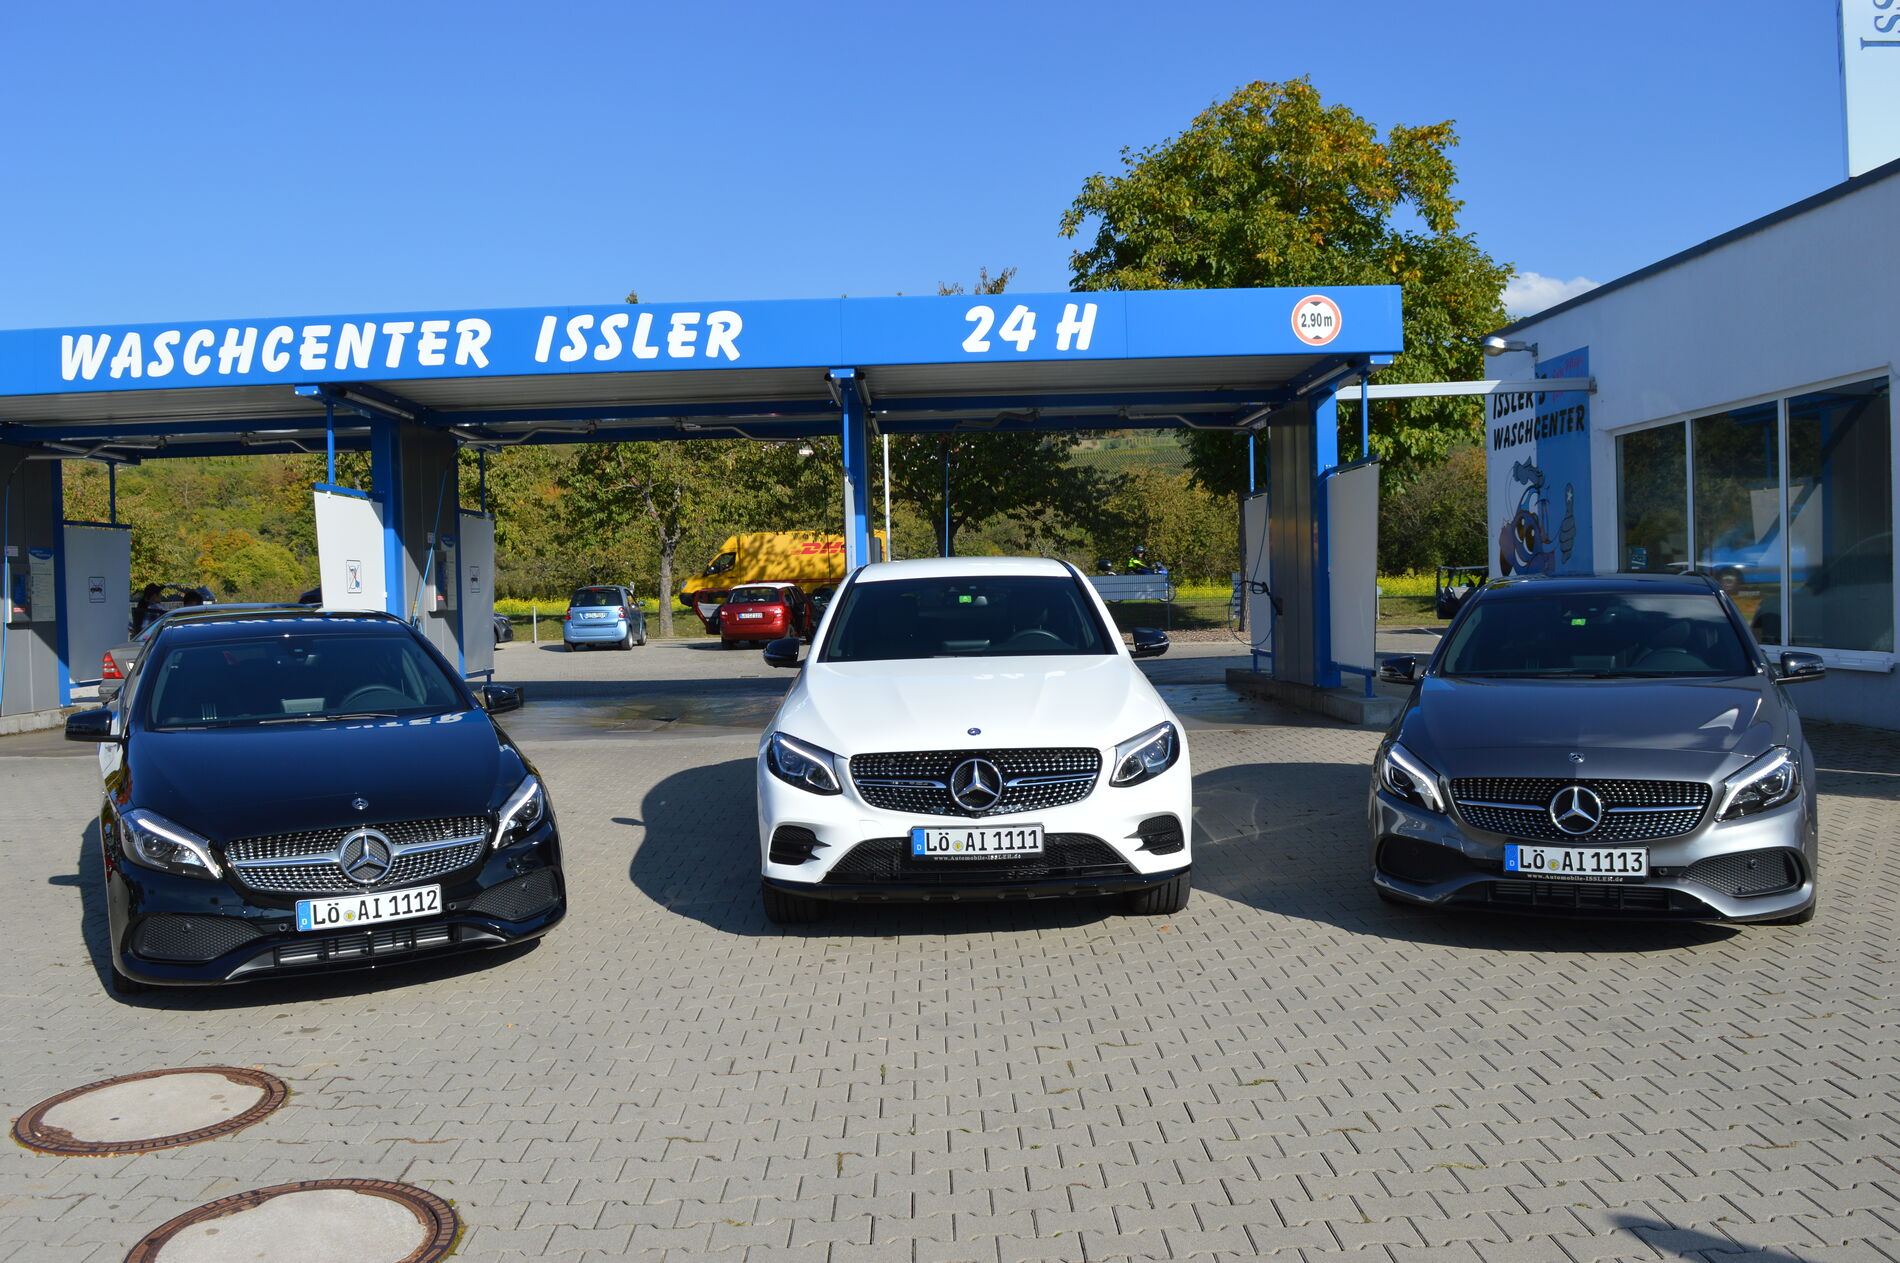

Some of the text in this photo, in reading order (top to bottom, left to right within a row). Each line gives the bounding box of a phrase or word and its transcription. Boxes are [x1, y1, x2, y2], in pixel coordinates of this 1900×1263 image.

[60, 302, 1098, 381] WASCHCENTER ISSLER 24 H
[1493, 404, 1585, 451] WASCHCENTER
[800, 542, 846, 554] DH
[926, 832, 950, 852] LÖ
[965, 831, 987, 851] AI
[993, 829, 1039, 851] 1111
[1519, 848, 1545, 870] LÖ
[1562, 851, 1586, 872] AI
[1591, 852, 1643, 873] 1113
[313, 902, 340, 926] LÖ
[358, 898, 383, 921] AI
[389, 889, 438, 917] 1112
